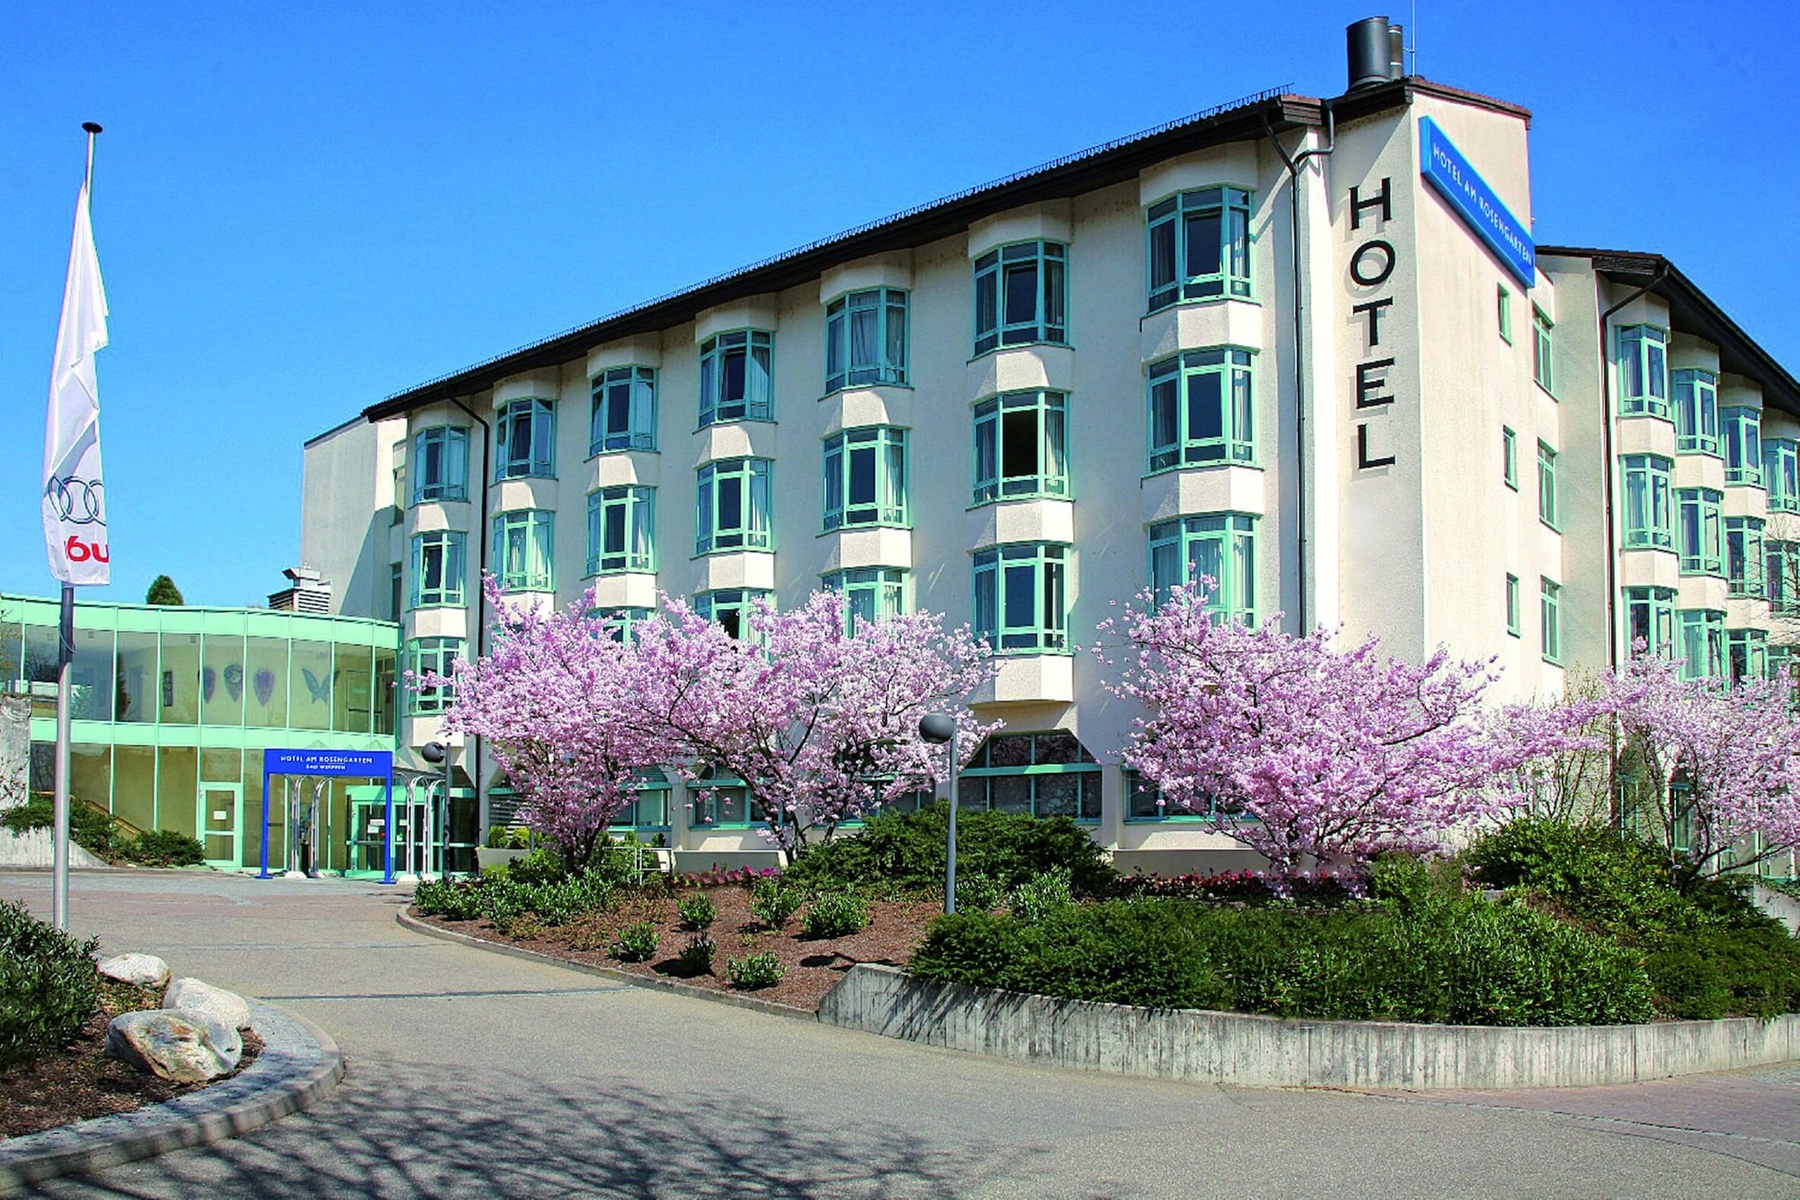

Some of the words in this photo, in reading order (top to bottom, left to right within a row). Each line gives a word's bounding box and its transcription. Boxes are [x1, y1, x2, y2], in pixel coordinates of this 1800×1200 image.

[1433, 143, 1463, 187] HOTEL
[1464, 179, 1477, 204] AM
[1479, 196, 1533, 266] ROSENGARTEN
[1349, 176, 1396, 470] HOTEL
[280, 755, 303, 763] HOTEL
[305, 755, 318, 763] AM
[319, 756, 373, 764] ROSENGARTEN
